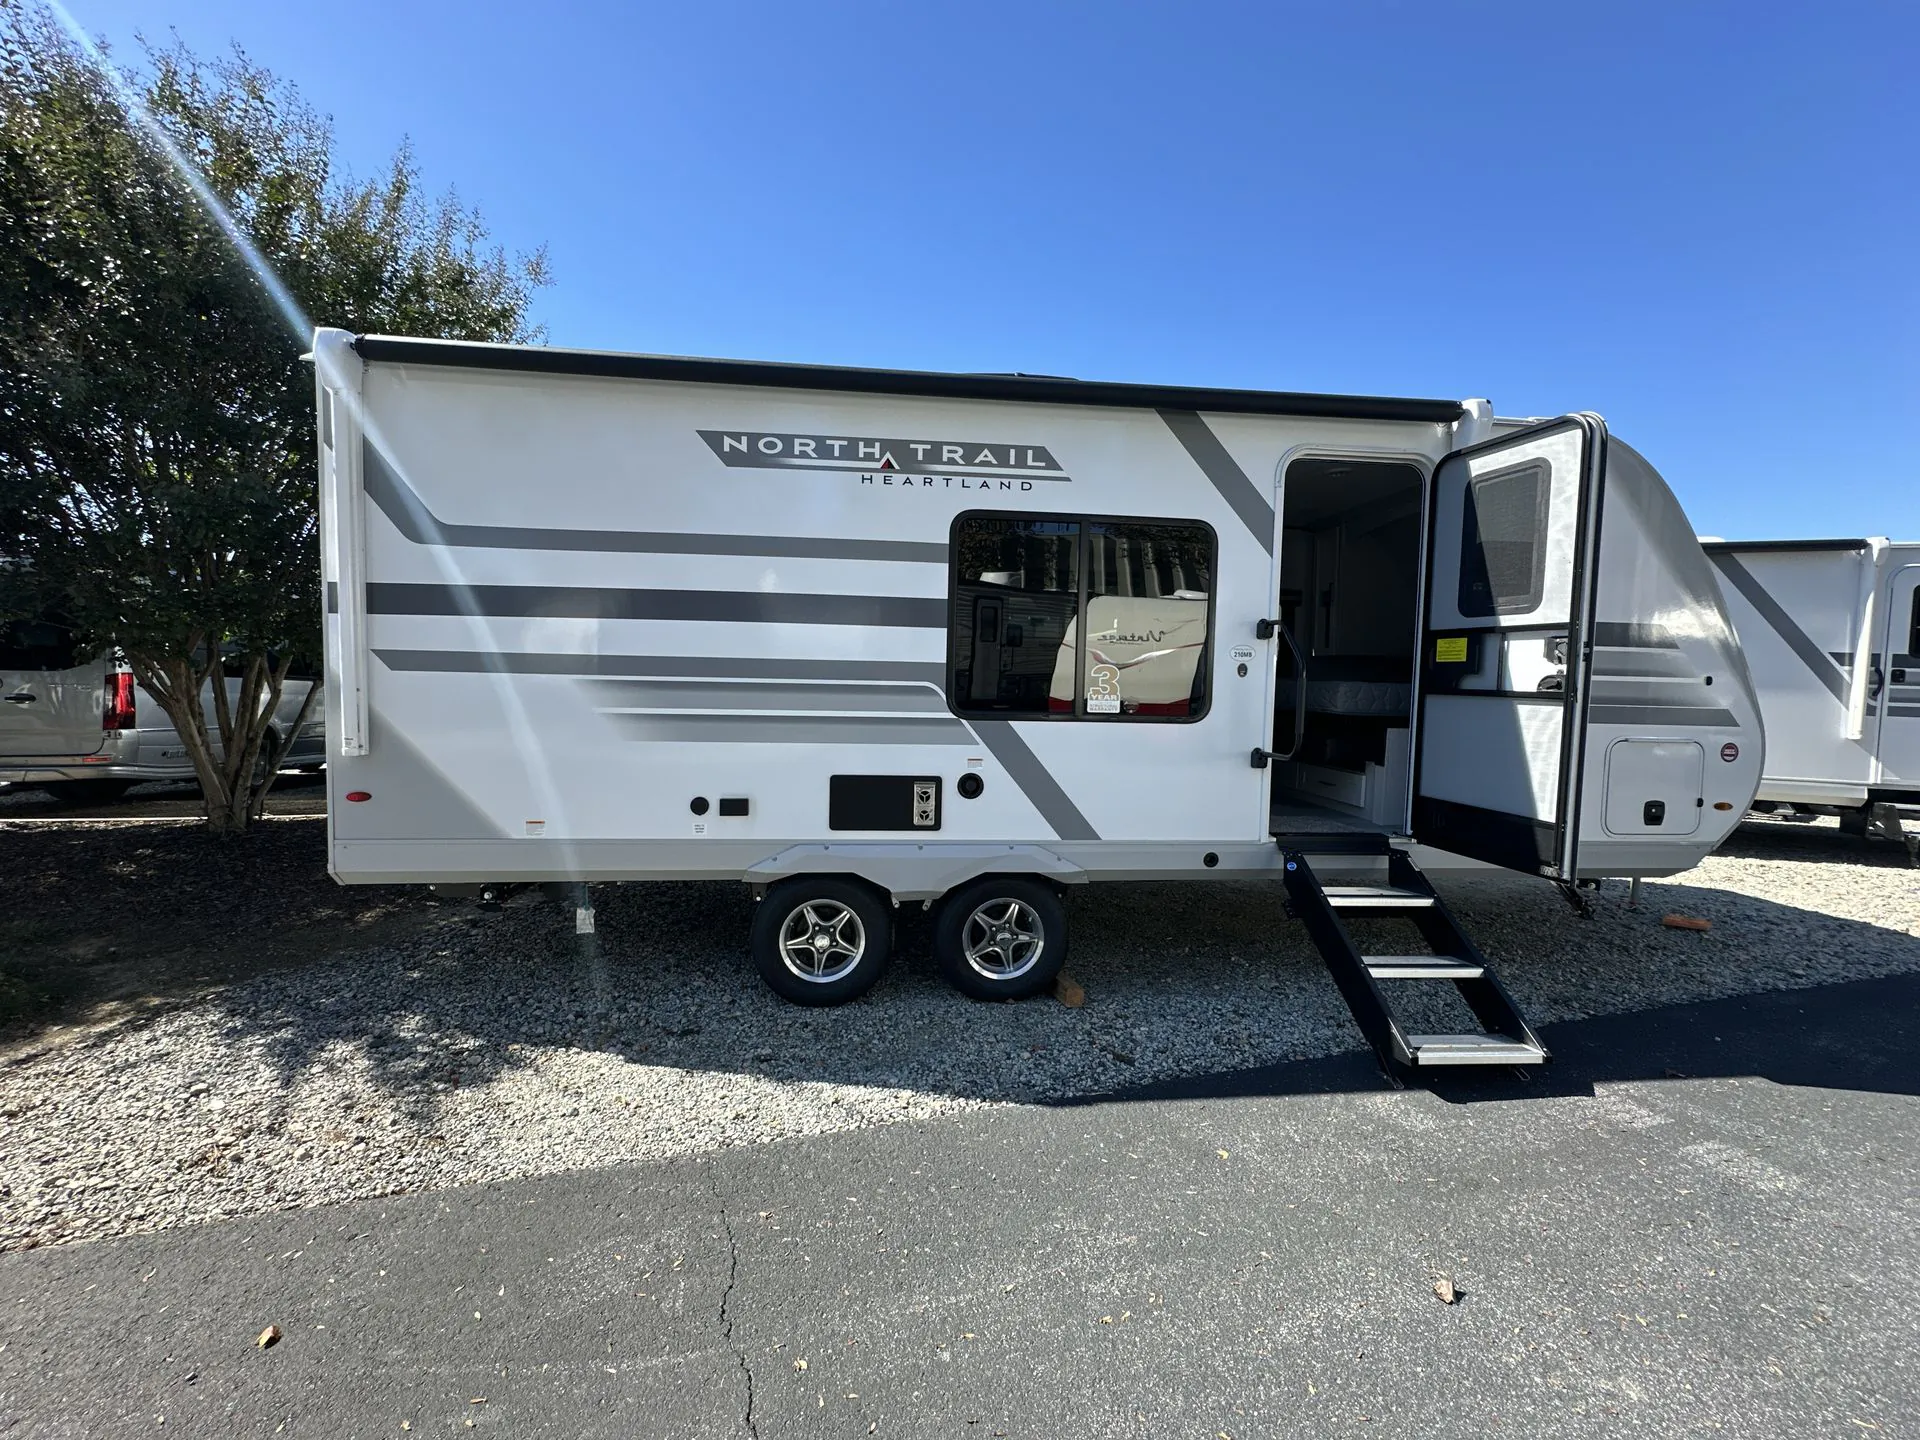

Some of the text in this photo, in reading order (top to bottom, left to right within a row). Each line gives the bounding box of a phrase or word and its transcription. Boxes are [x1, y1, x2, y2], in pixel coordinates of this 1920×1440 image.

[723, 435, 1047, 467] NORTH TRAIL
[861, 474, 1033, 491] HEARTLAND
[1090, 664, 1120, 695] 3
